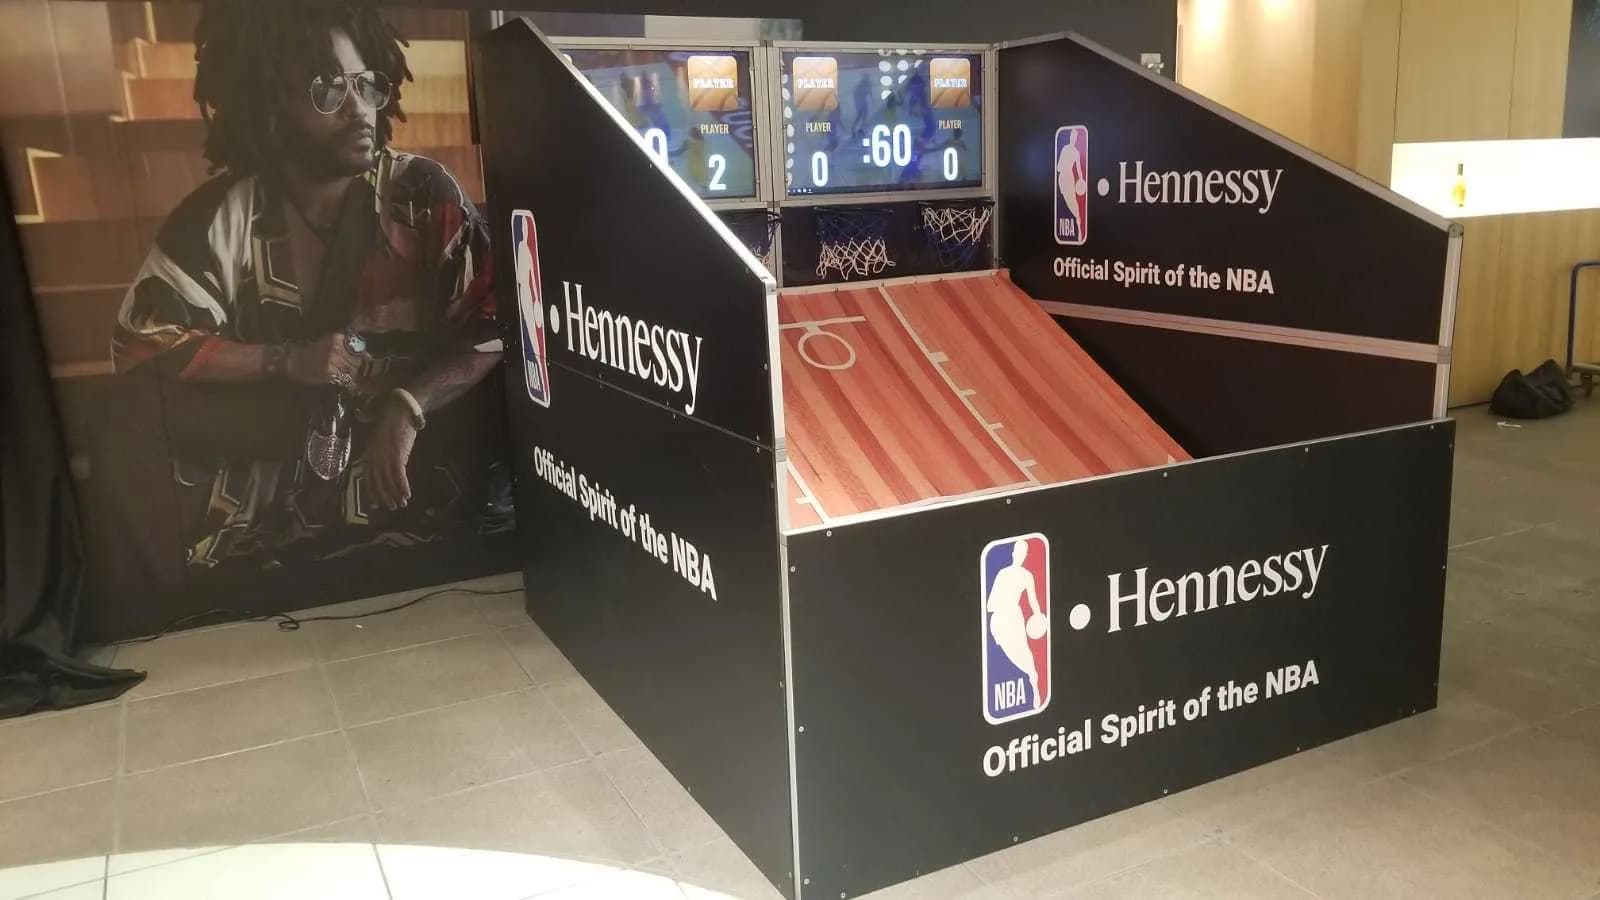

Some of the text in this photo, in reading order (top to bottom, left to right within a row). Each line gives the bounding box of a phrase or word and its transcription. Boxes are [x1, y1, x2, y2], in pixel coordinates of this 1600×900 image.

[700, 123, 730, 135] PLAYER
[805, 121, 832, 133] PLAYER
[938, 119, 962, 130] PLAYER
[862, 123, 912, 168] :60
[943, 147, 959, 181] 0
[708, 153, 727, 191] 2
[811, 151, 829, 187] 0
[1117, 160, 1284, 215] Hennessy
[1058, 217, 1076, 238] NBA
[1053, 257, 1275, 295] Official Spirit of the NBA
[562, 280, 704, 416] Hennessy
[534, 445, 718, 601] Official Spirit of the NBA
[1106, 544, 1330, 634] Hennessy
[994, 677, 1027, 712] NBA
[982, 659, 1320, 778] Official Spirit of the NBA
